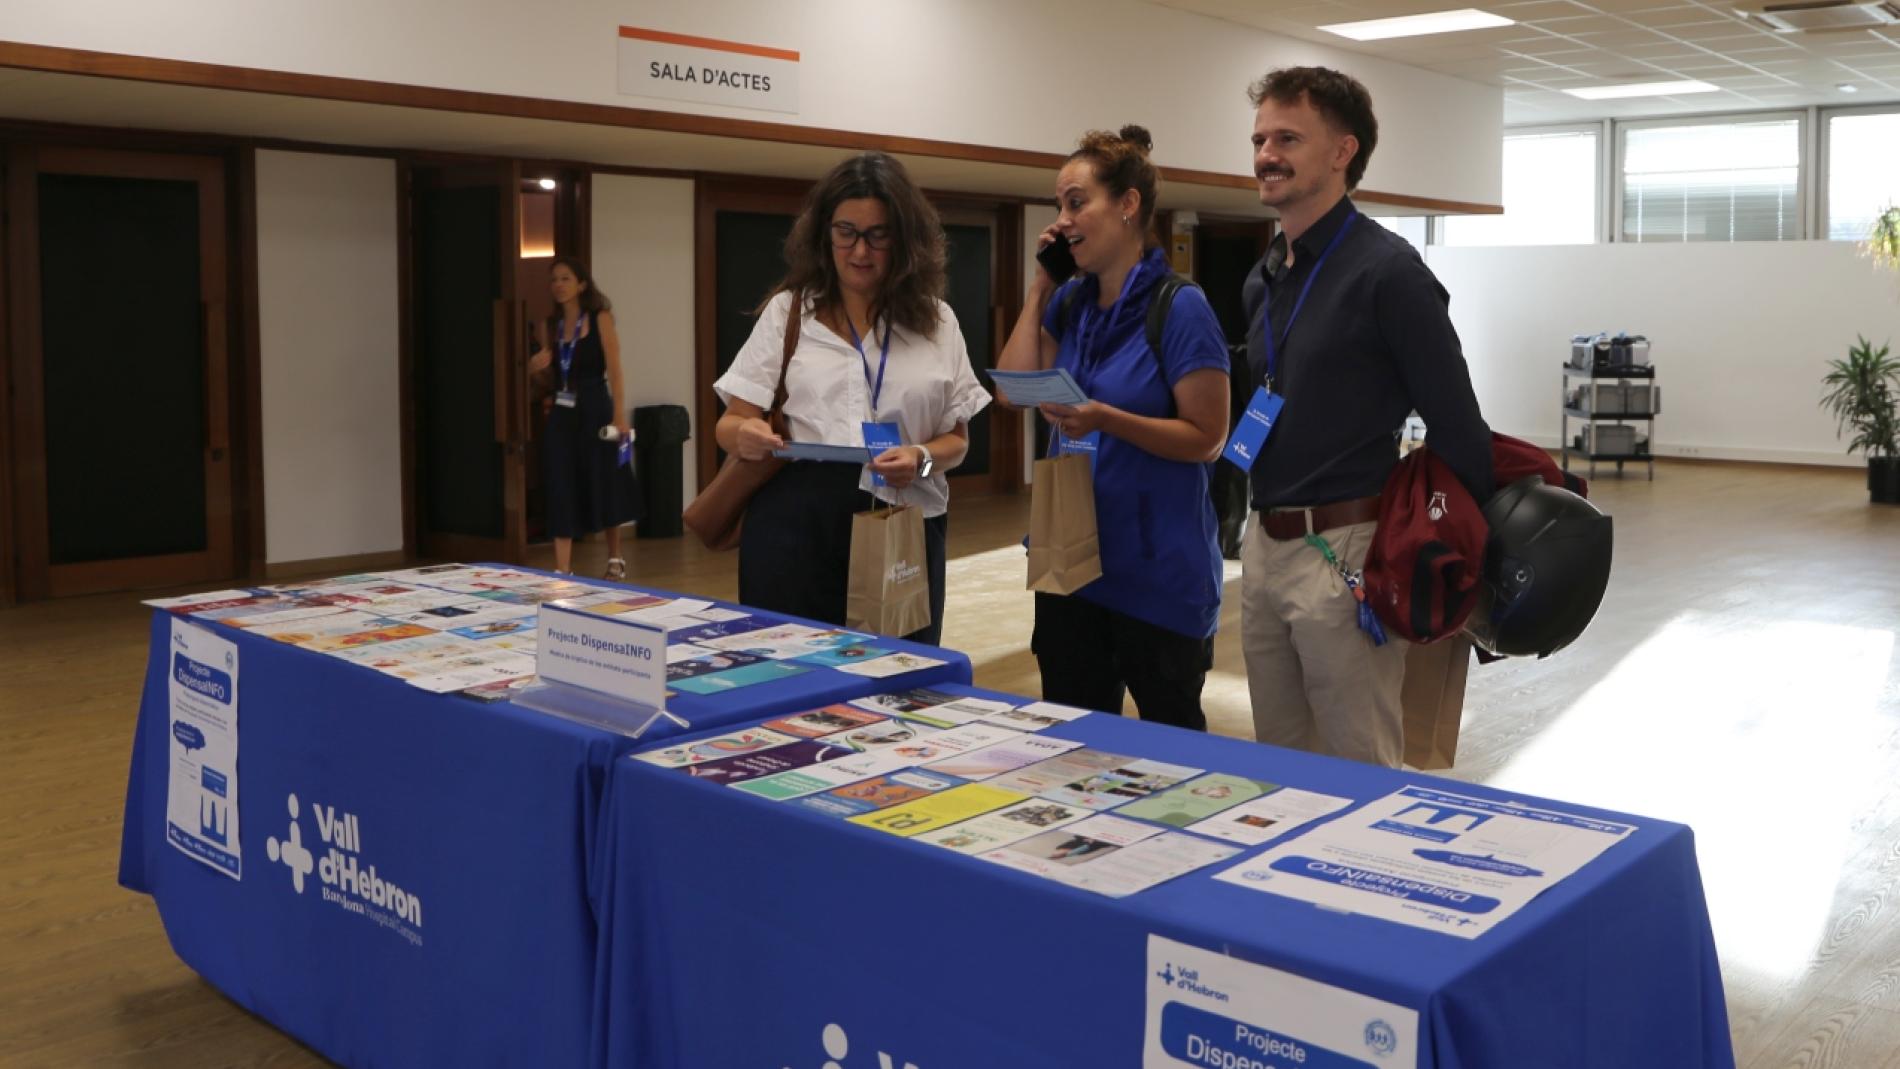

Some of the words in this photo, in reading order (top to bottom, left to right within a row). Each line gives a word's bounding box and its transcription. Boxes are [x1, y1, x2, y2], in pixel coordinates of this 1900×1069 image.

[650, 61, 697, 83] SALA
[702, 68, 771, 92] D'ACTES
[548, 628, 579, 644] Projecte
[581, 633, 652, 661] DispensaINFO
[313, 802, 360, 853] Vall
[318, 848, 422, 928] d'Hebron
[1306, 861, 1472, 903] DispensaINFO
[1340, 877, 1410, 898] Projecte
[1177, 965, 1199, 981] Vall
[1177, 980, 1229, 1002] d'Hebron
[1186, 1033, 1276, 1069] Dispen
[1235, 1024, 1306, 1063] Projecte
